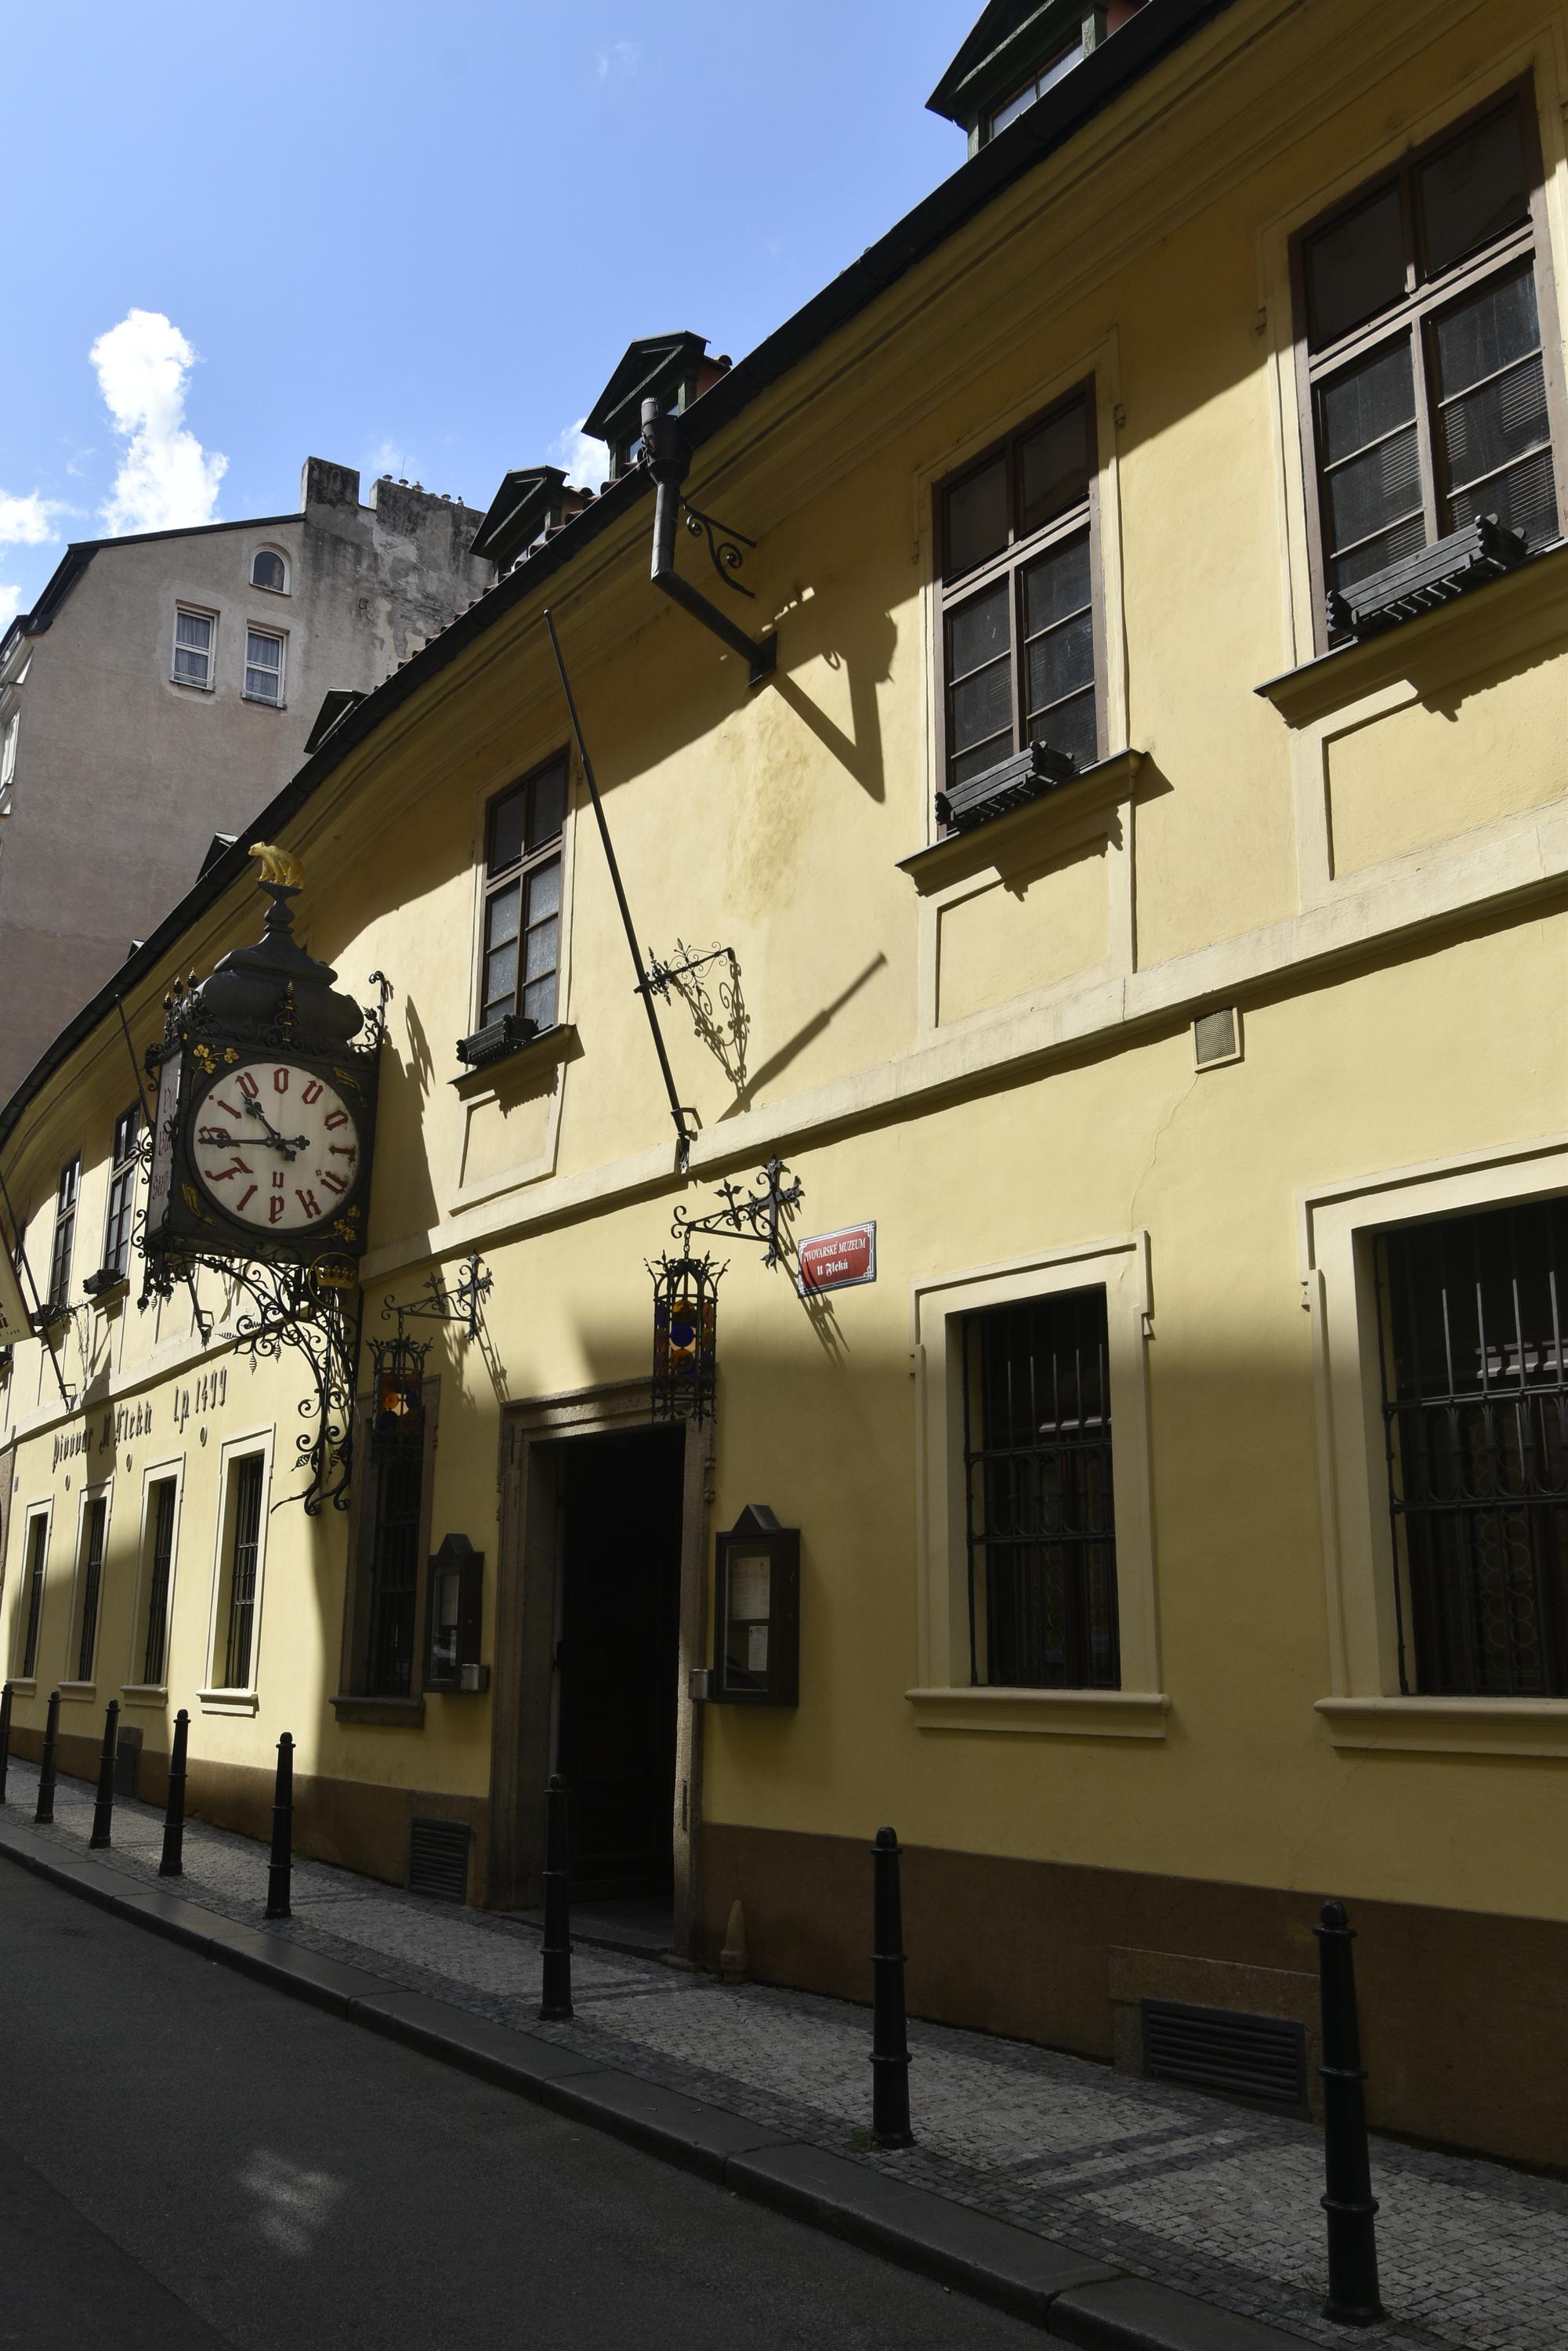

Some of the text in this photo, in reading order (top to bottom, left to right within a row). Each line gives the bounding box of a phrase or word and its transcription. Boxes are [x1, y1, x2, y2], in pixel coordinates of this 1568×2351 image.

[804, 1237, 866, 1262] PIVOVARSKÉ MUZEUM
[195, 1365, 227, 1415] 1499
